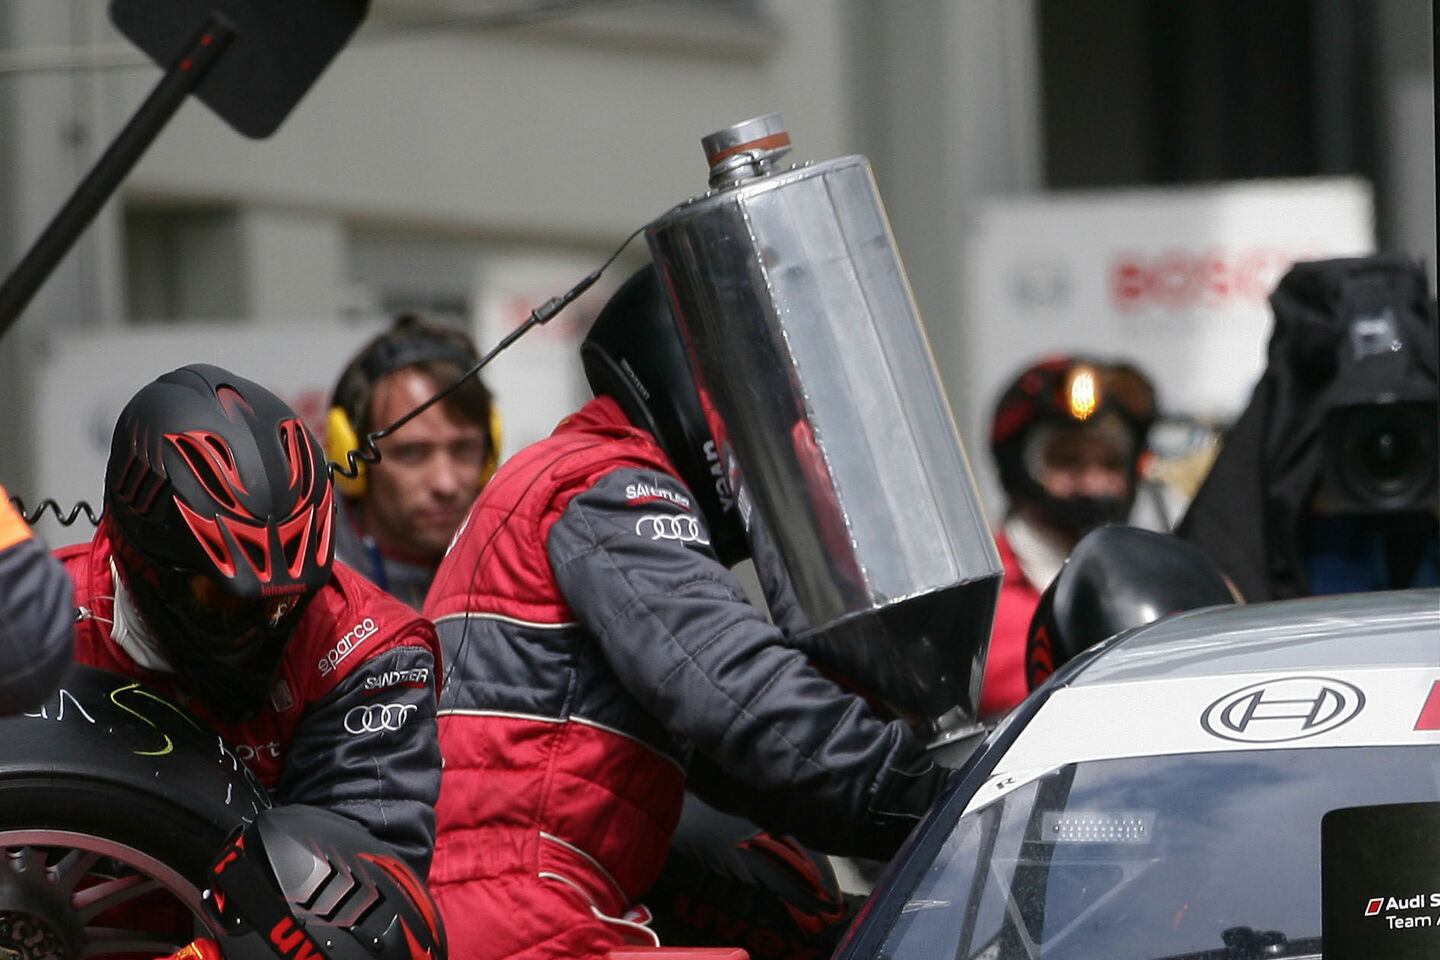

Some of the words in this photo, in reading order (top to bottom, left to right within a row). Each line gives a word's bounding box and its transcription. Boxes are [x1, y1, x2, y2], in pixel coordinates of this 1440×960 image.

[1113, 251, 1305, 309] BOSC
[318, 618, 379, 677] sparco
[1385, 896, 1424, 911] Audi
[1386, 915, 1431, 929] Team
